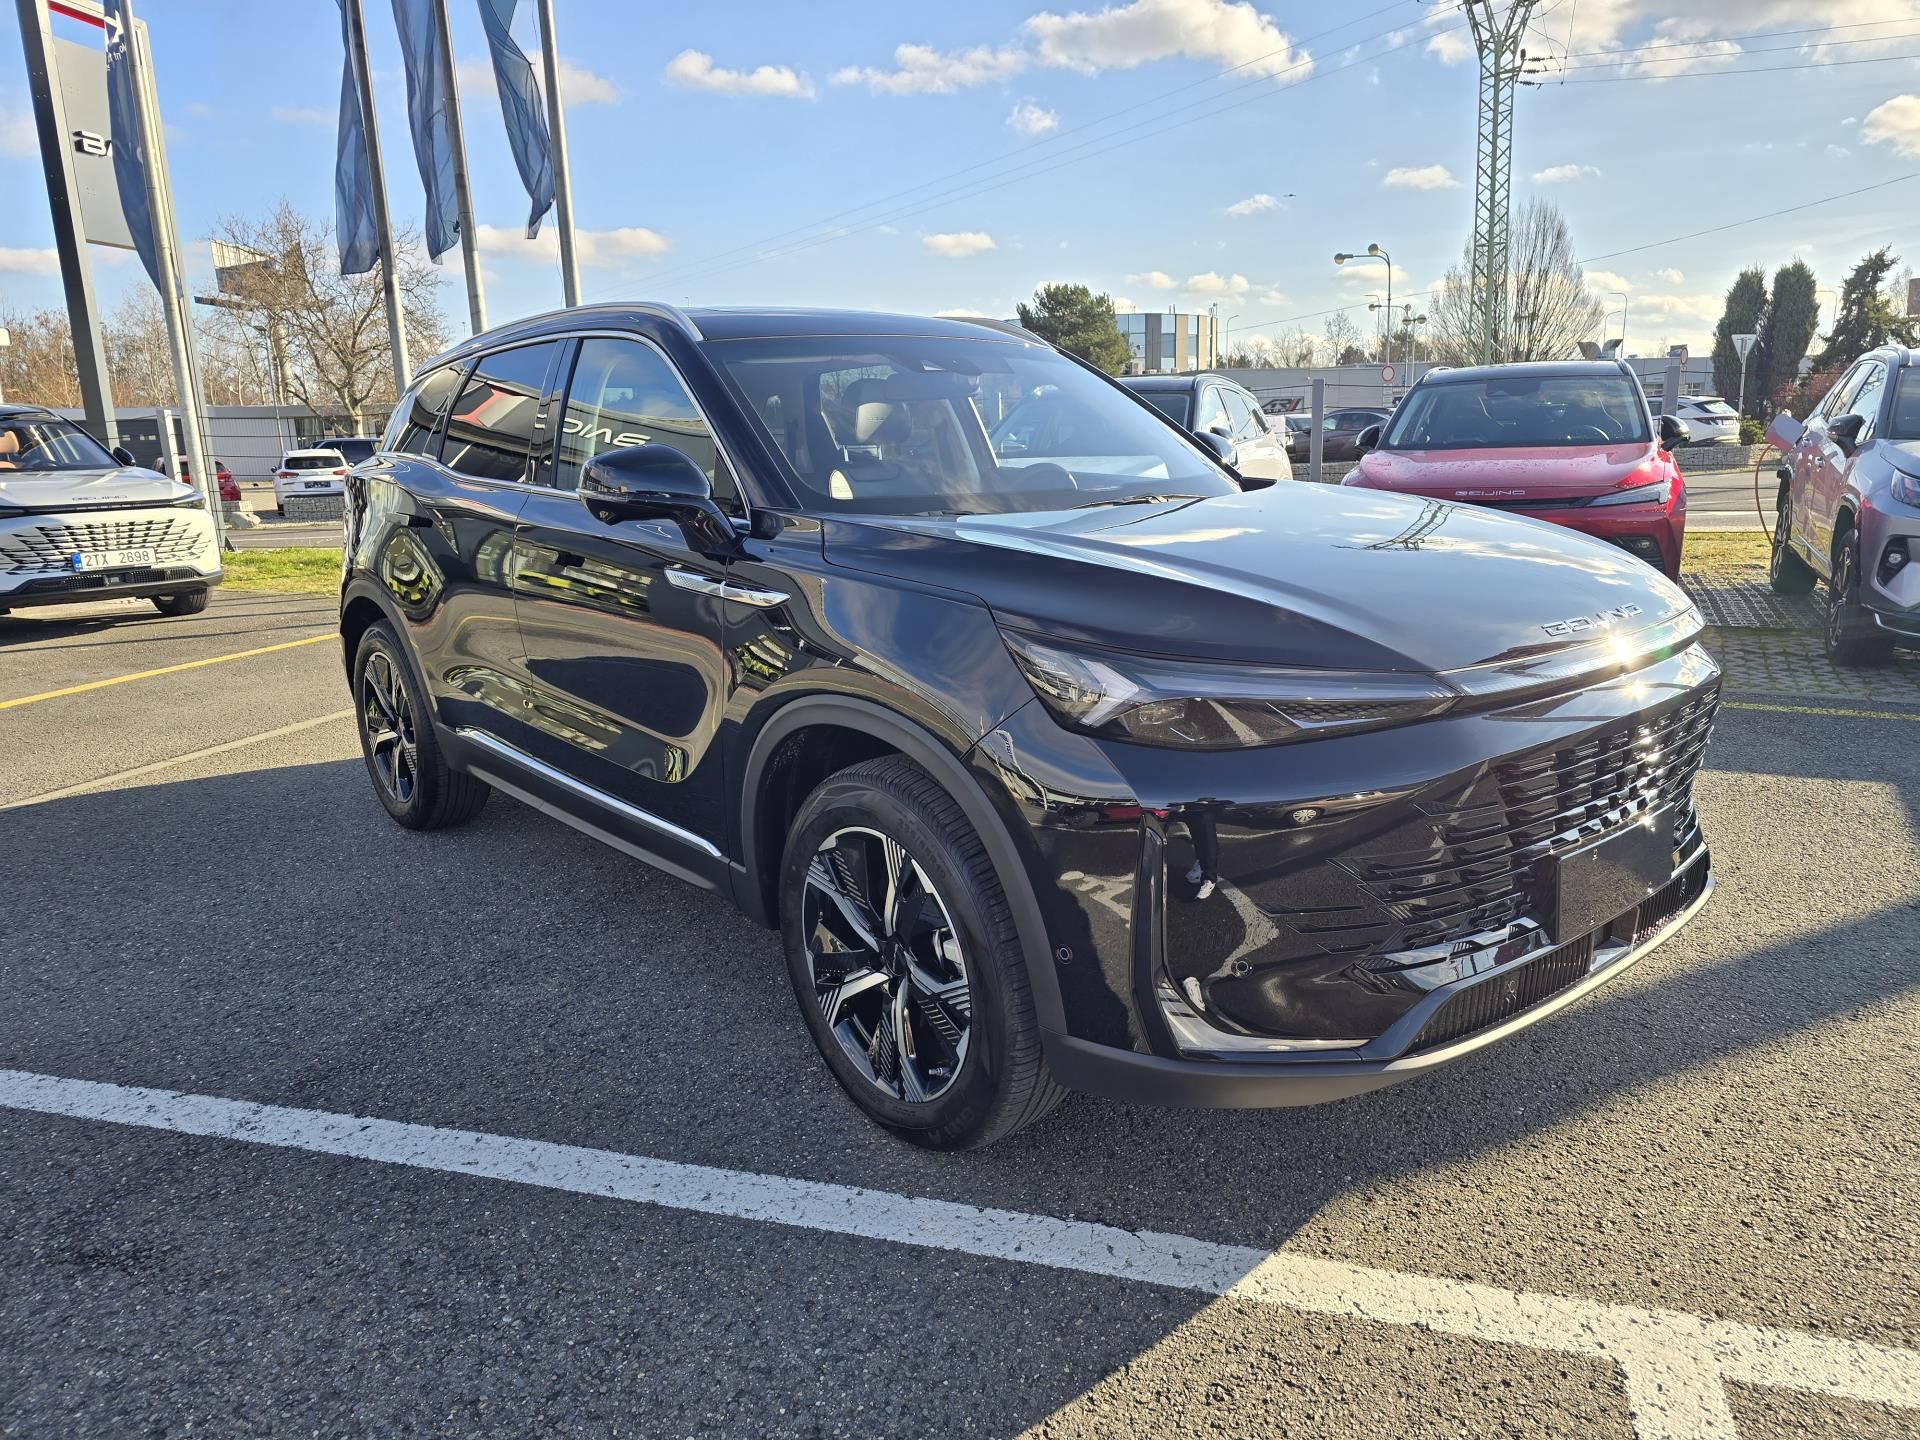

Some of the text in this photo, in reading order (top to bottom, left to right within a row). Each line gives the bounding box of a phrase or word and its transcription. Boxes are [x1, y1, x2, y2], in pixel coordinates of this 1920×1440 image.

[84, 550, 150, 567] 2TX 2698
[1541, 602, 1644, 637] BEIJING
